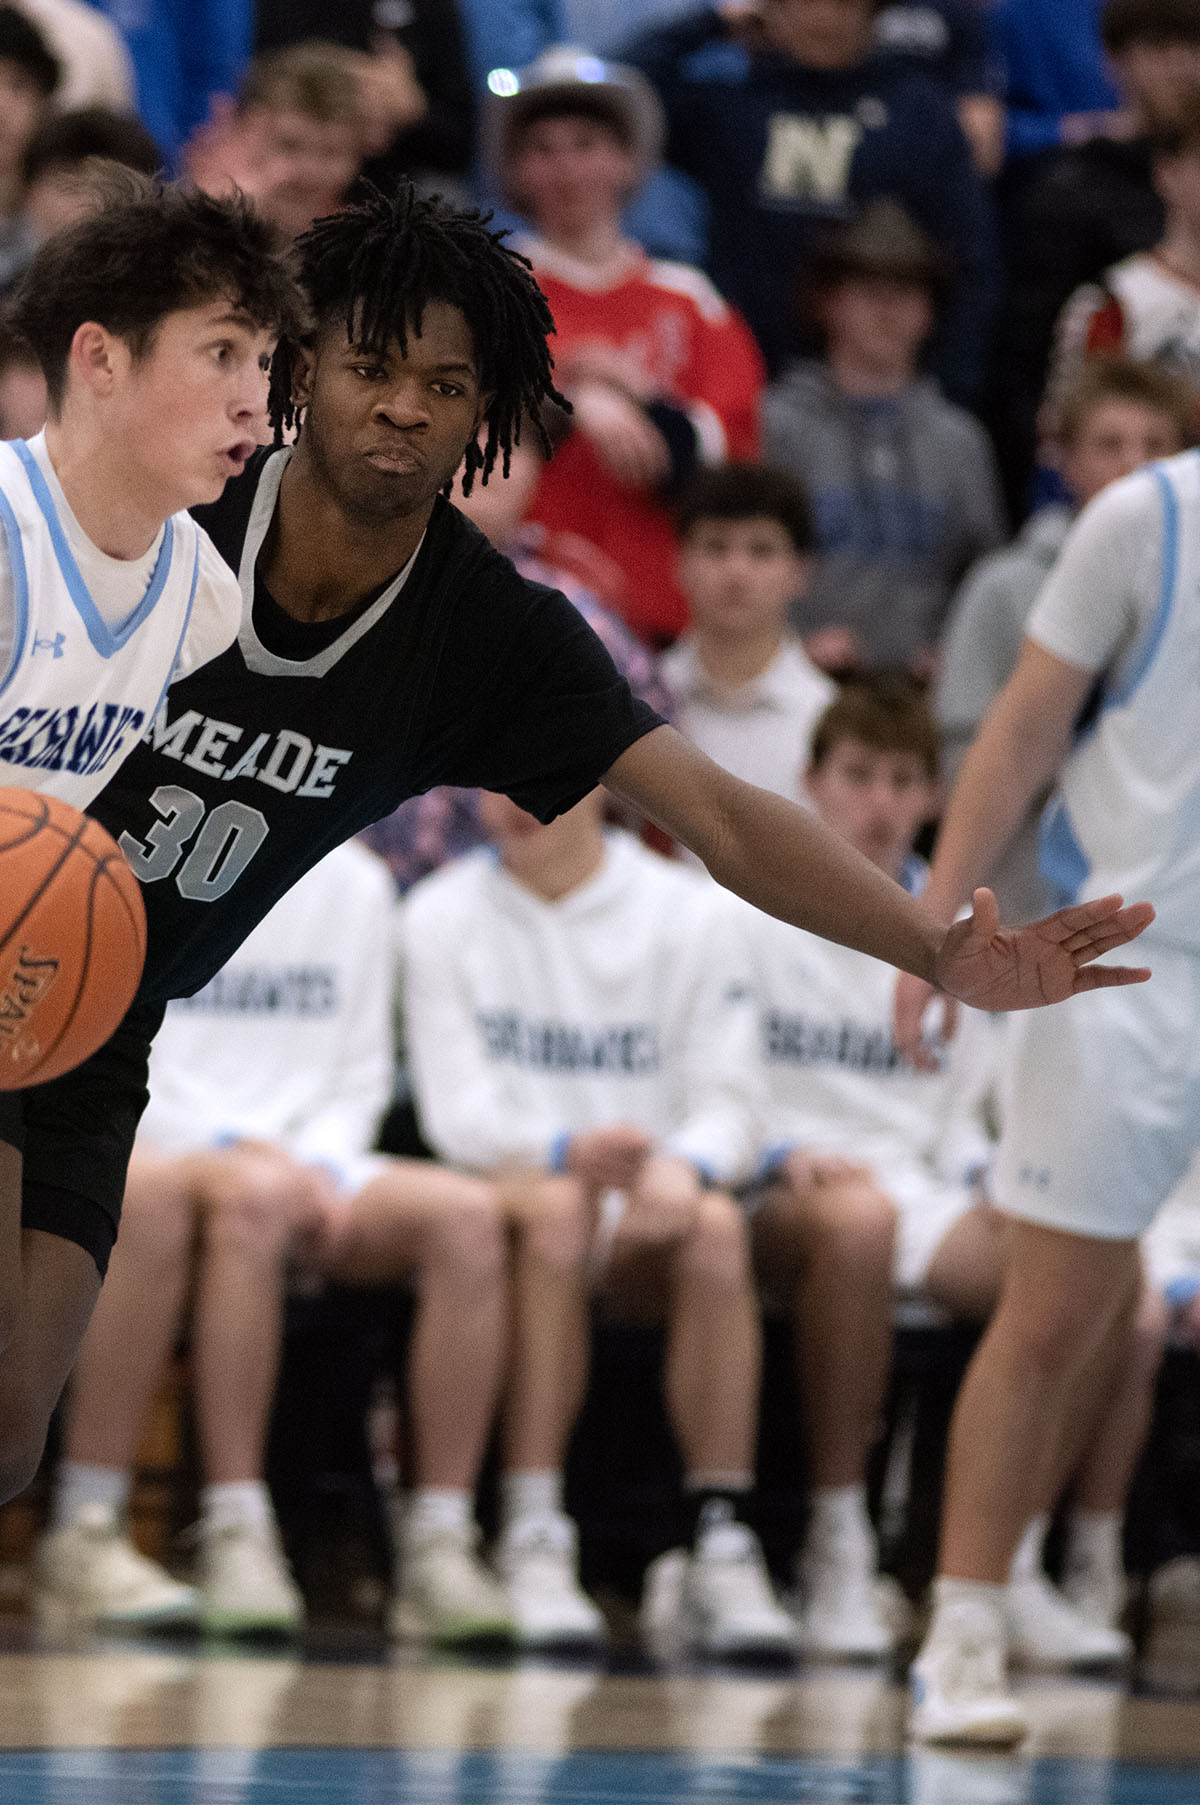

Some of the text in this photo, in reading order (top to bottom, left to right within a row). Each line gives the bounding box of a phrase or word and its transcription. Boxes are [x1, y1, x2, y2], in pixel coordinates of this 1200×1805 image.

[760, 112, 863, 202] N
[142, 698, 354, 799] MEADE
[117, 784, 270, 902] 30
